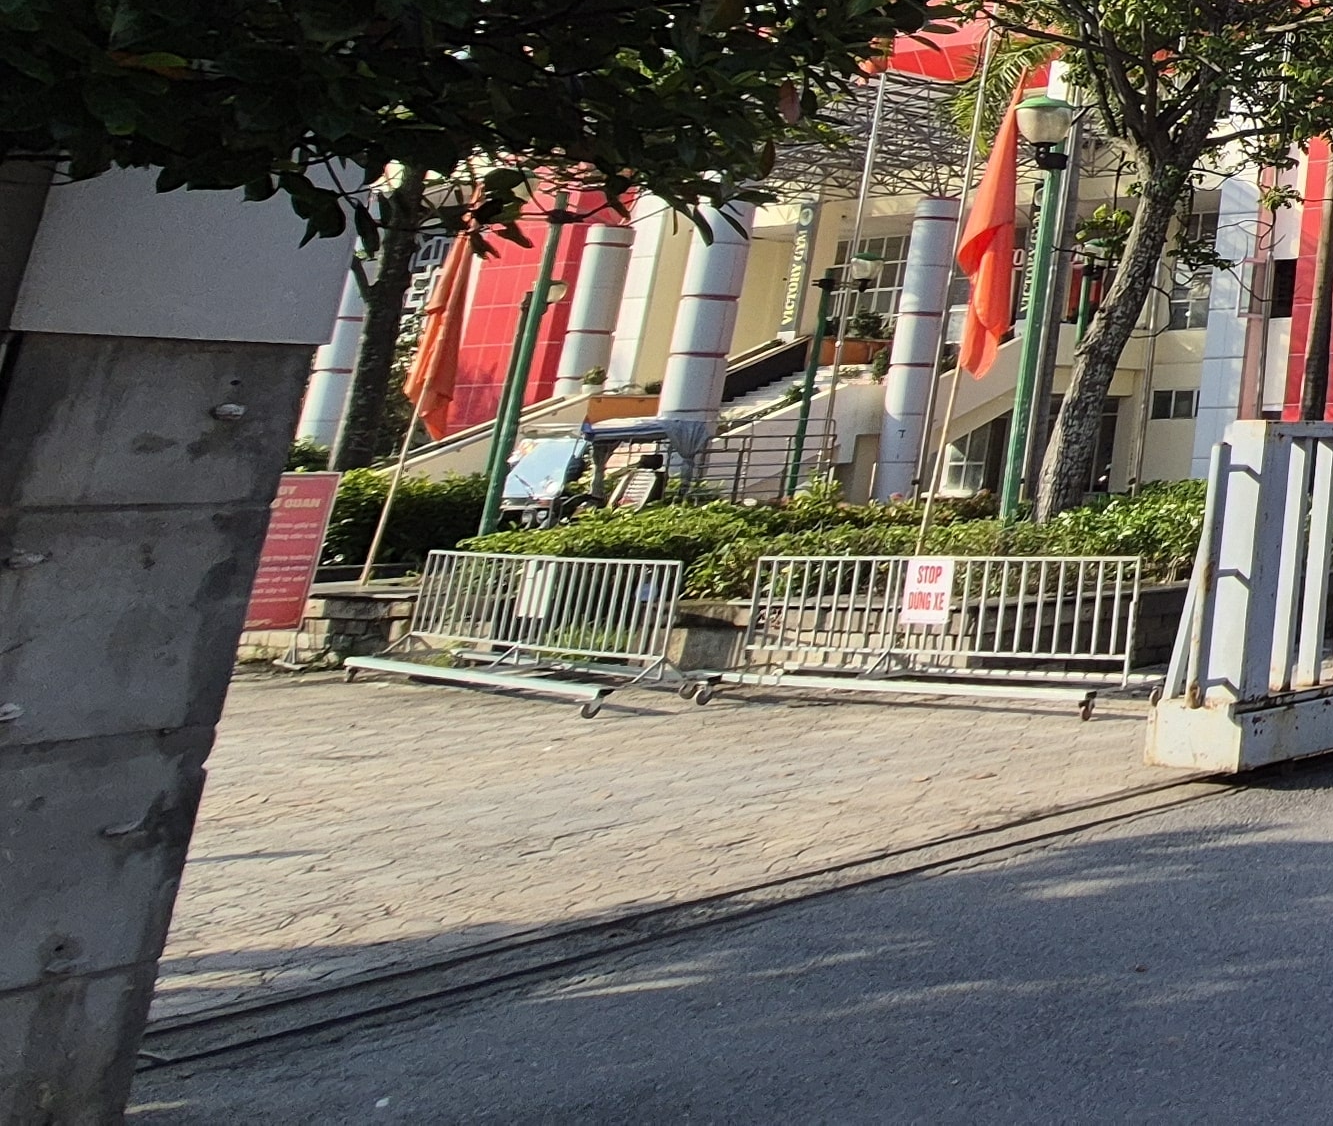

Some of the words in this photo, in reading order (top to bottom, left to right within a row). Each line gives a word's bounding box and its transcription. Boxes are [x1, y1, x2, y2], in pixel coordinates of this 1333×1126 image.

[781, 263, 802, 325] VICTORY
[793, 230, 808, 262] GYM
[917, 564, 943, 585] STOP
[932, 591, 946, 611] XE
